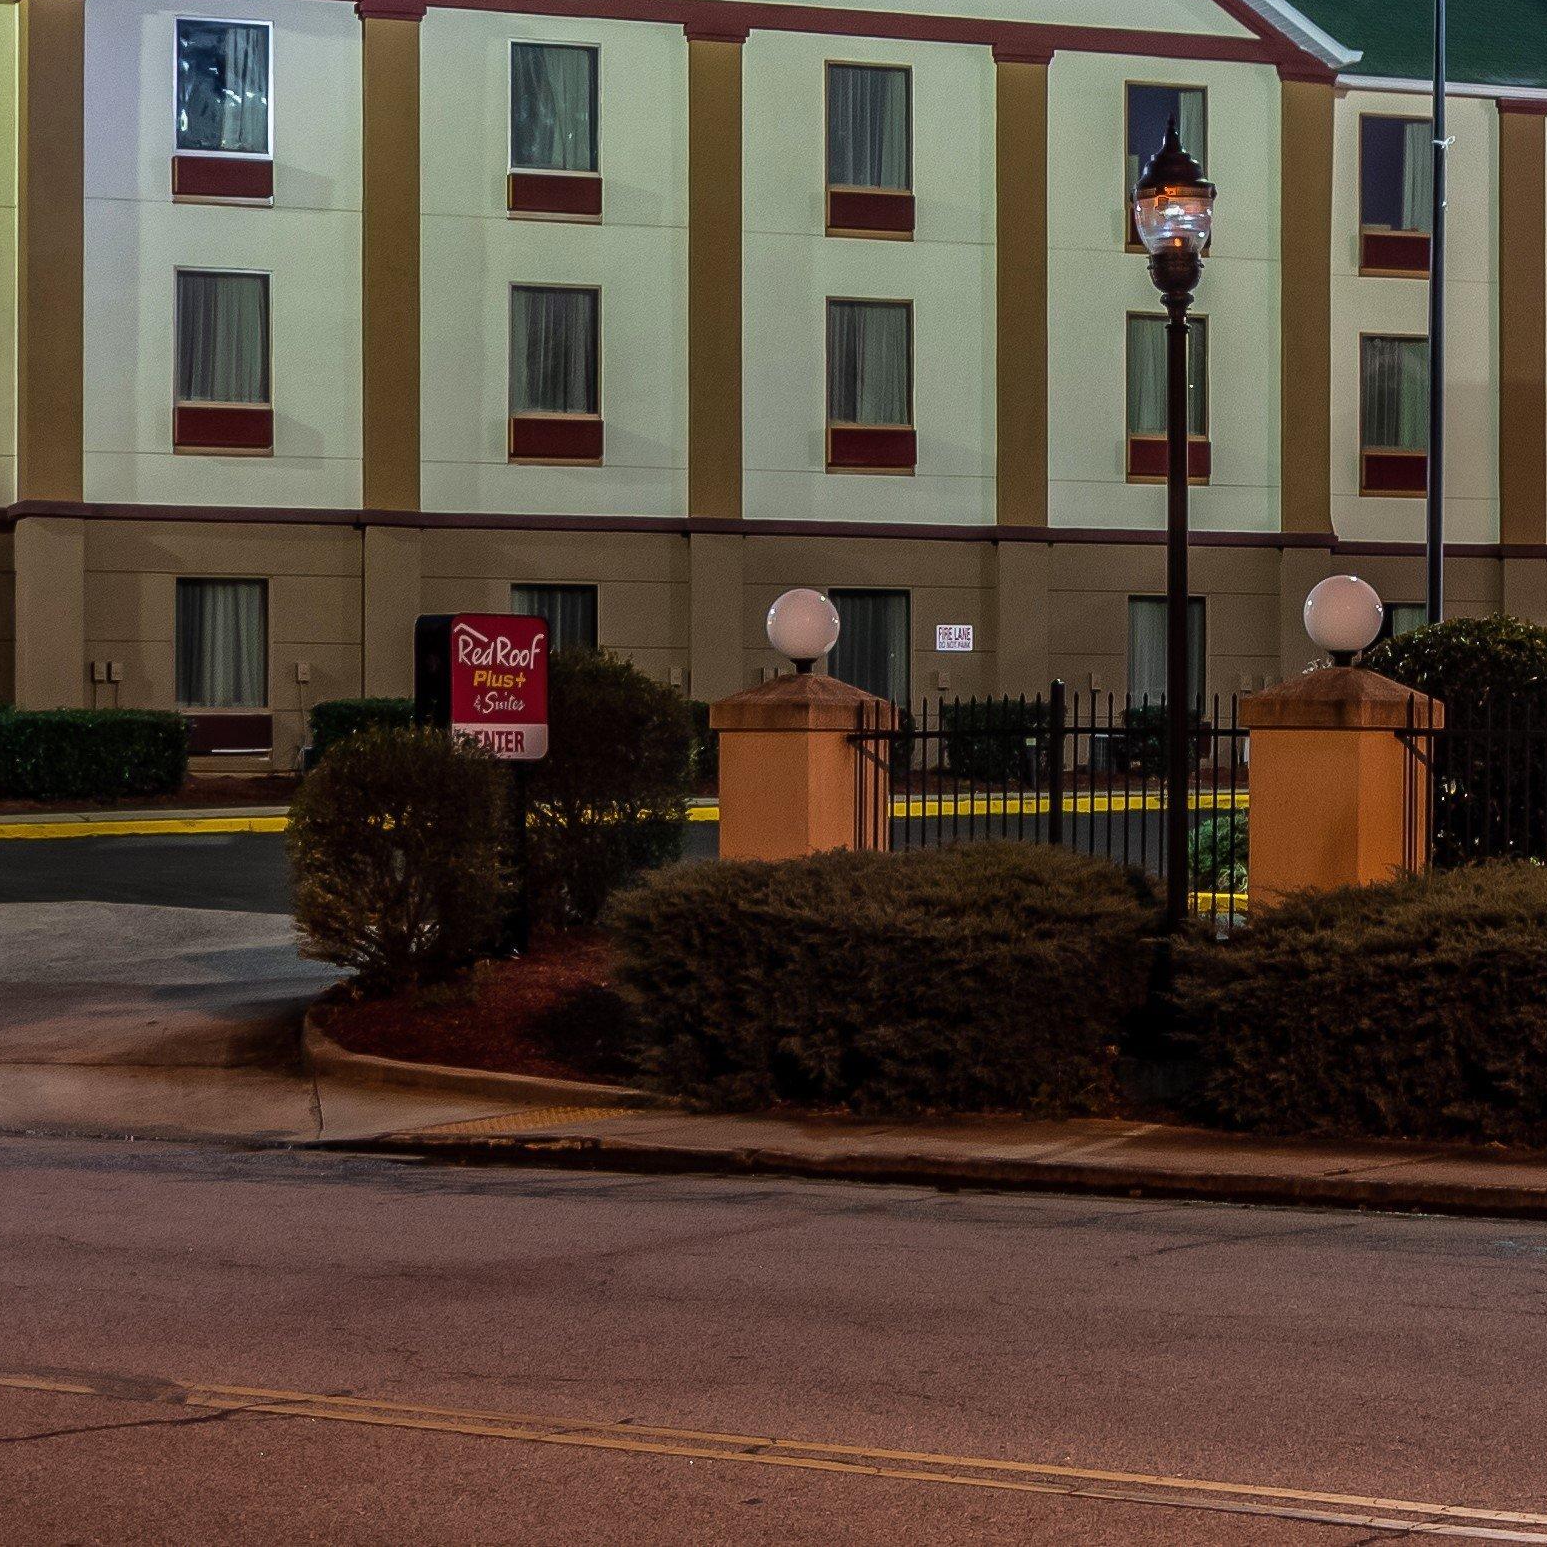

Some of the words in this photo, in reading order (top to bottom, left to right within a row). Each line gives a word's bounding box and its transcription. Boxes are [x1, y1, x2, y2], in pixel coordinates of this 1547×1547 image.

[939, 627, 953, 641] FIRE
[954, 627, 971, 641] LANE
[458, 634, 494, 666] Red
[496, 633, 544, 669] Roof
[473, 670, 526, 688] Plus+
[481, 691, 525, 714] Suites
